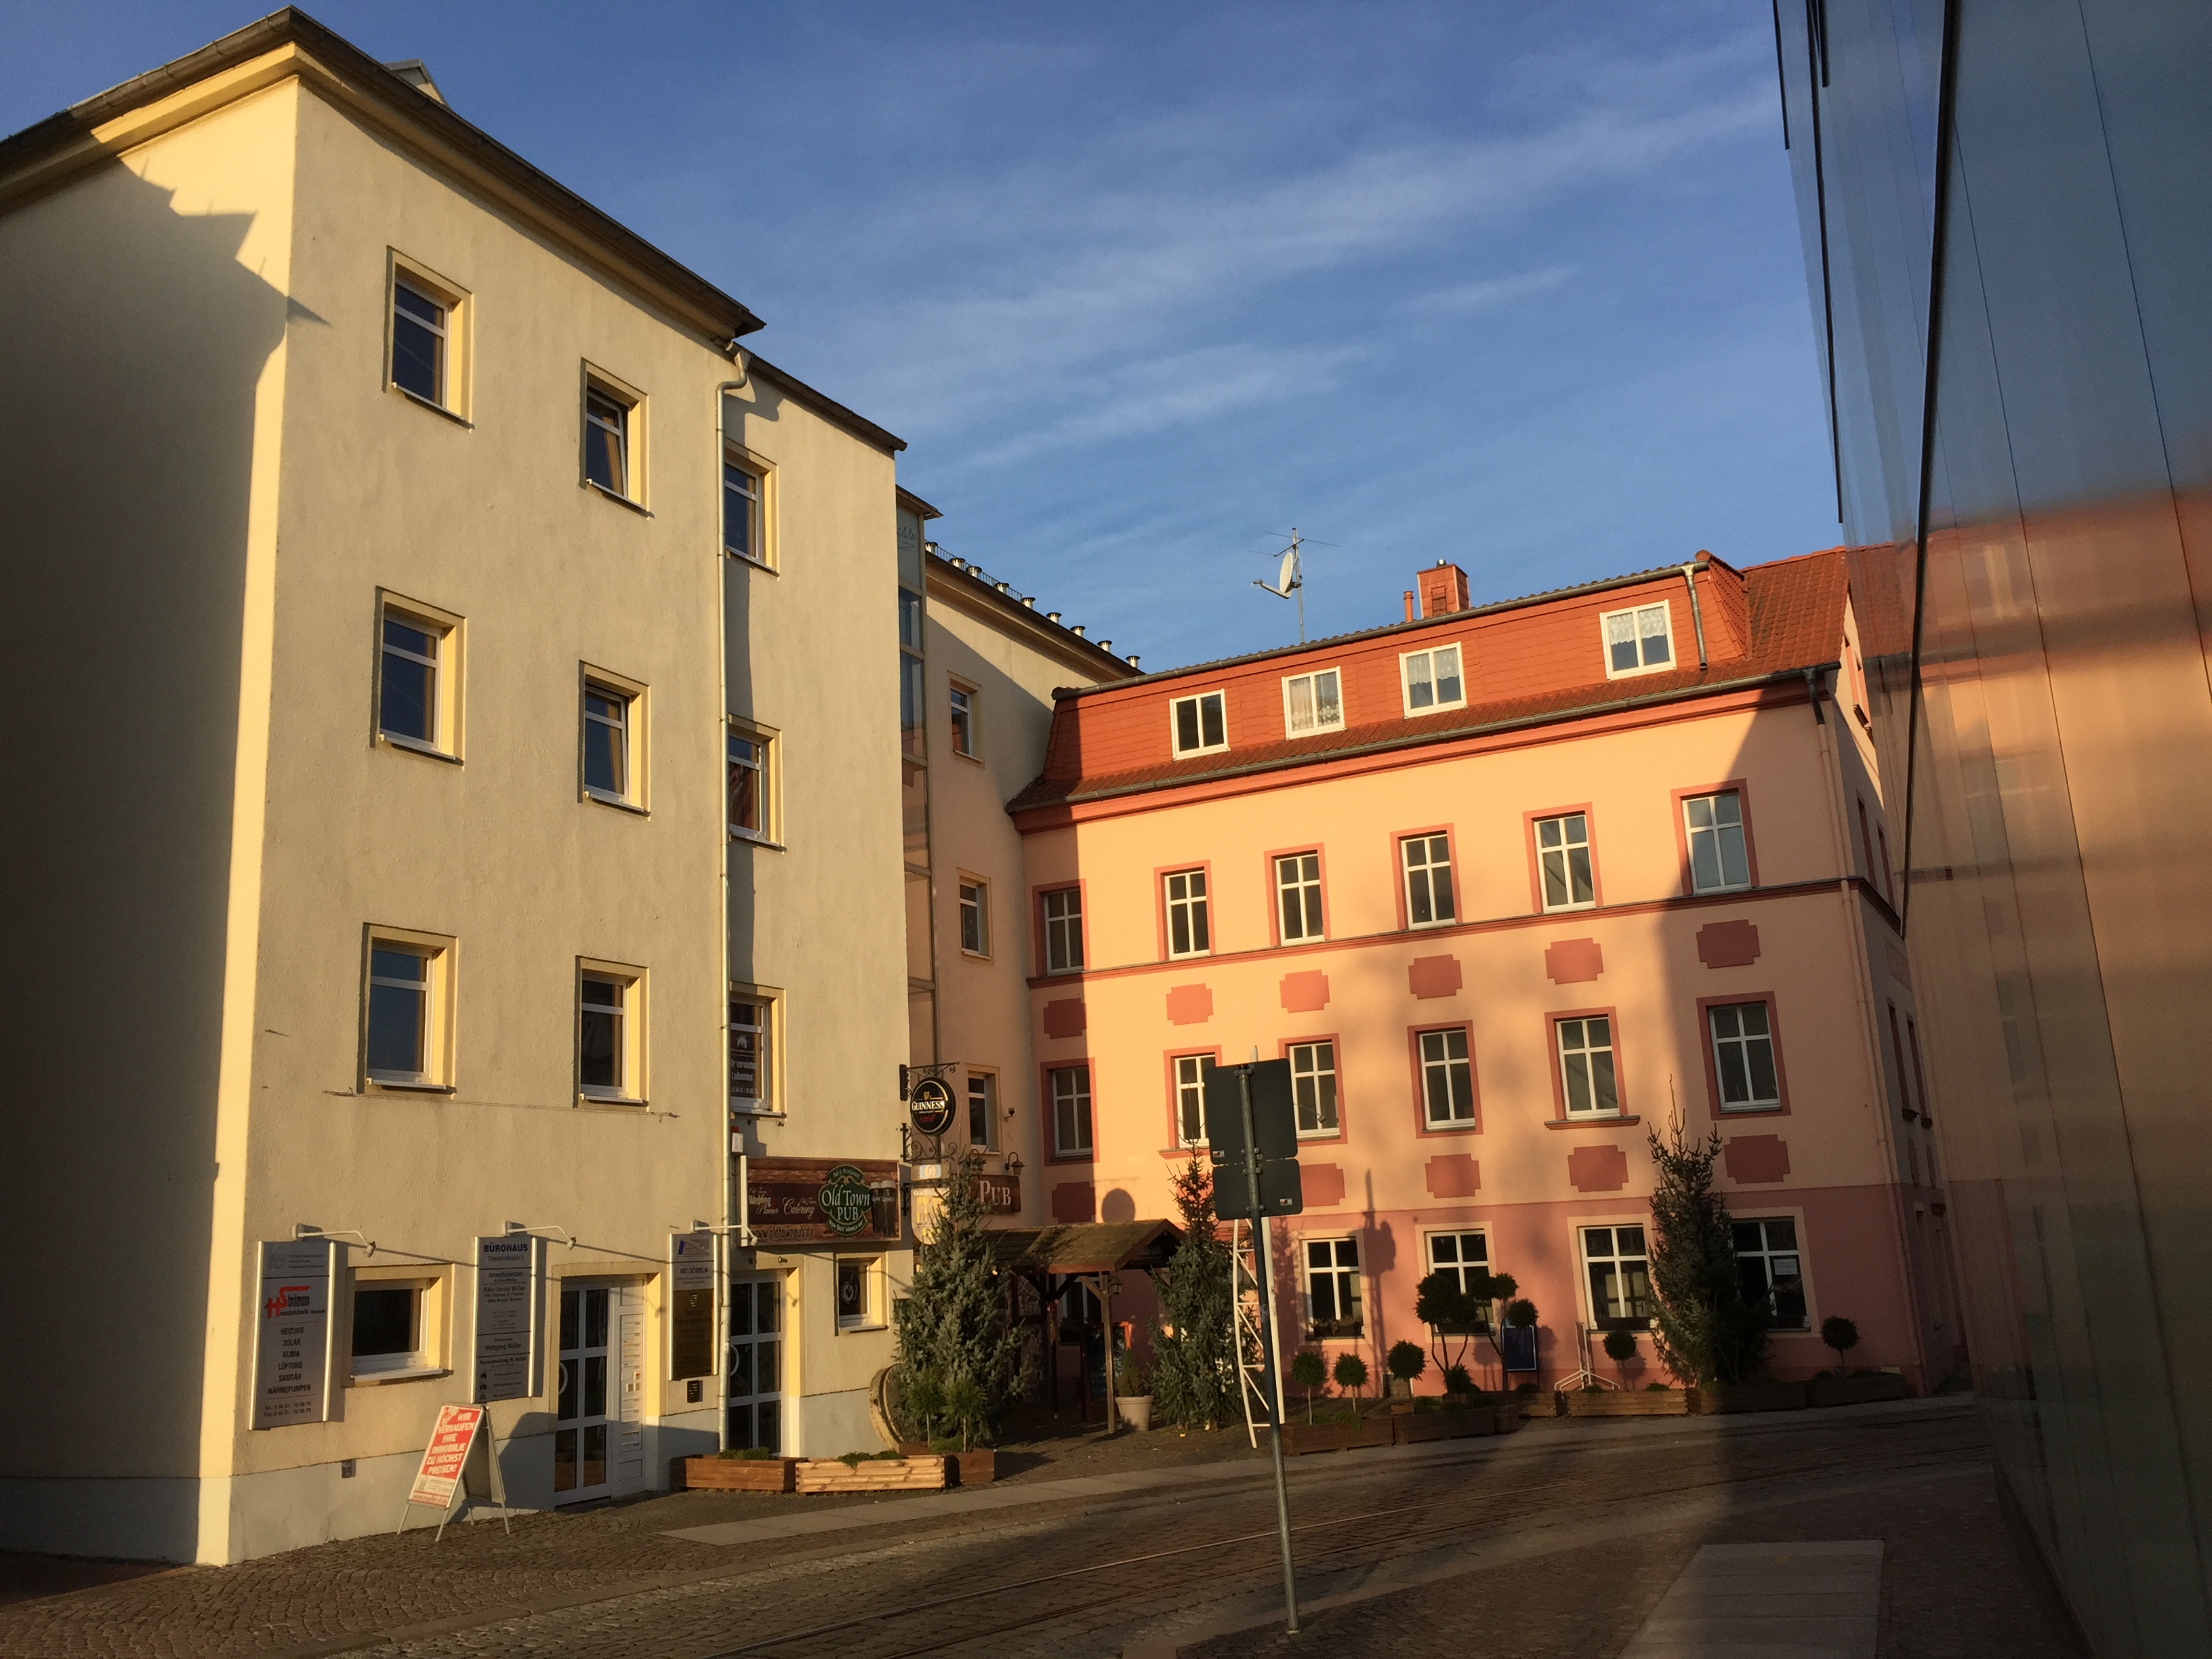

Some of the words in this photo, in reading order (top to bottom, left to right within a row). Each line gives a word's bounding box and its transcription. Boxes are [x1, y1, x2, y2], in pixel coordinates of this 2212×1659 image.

[912, 1100, 945, 1111] GUINNESS
[821, 1184, 844, 1206] Old
[842, 1190, 870, 1206] Town
[979, 1180, 1012, 1206] PUB
[782, 1197, 815, 1220] Catering
[837, 1207, 859, 1221] PUB
[483, 1242, 528, 1252] BÜROHAUS
[283, 1338, 301, 1347] SOLAR
[278, 1361, 303, 1370] LÜFTUNG
[278, 1373, 302, 1382] SANITÄR
[267, 1385, 311, 1395] WÄRMEPUMPEN
[457, 1412, 472, 1422] WIR
[438, 1422, 475, 1434] VERKAUFEN
[442, 1433, 457, 1443] IHRE
[431, 1443, 466, 1454] IMMOBILIE
[426, 1456, 436, 1465] ZU
[436, 1453, 464, 1464] HÖCHST
